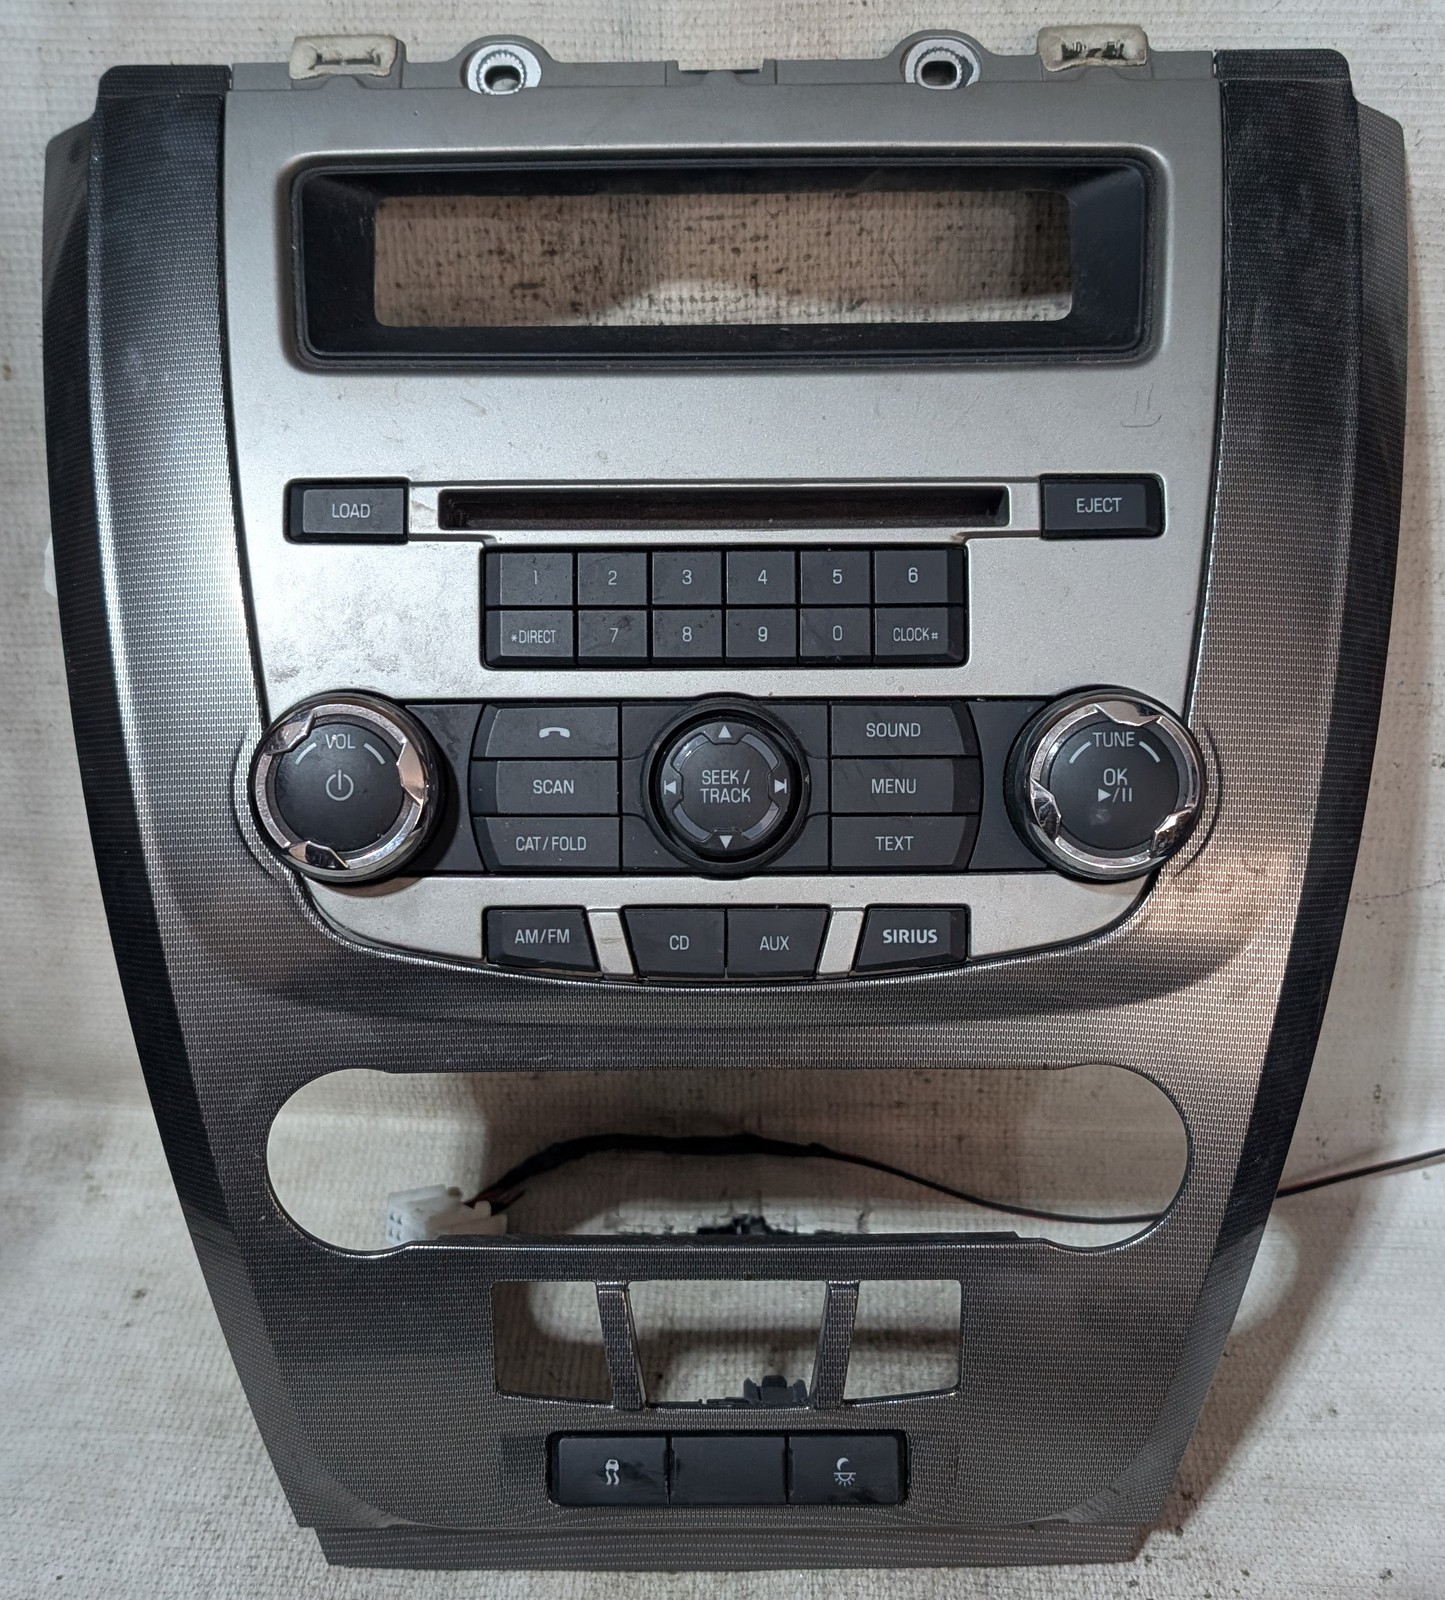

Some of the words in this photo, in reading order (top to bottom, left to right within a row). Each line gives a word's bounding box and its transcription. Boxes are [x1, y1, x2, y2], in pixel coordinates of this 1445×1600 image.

[331, 502, 371, 519] LOAD
[1076, 497, 1123, 513] EJECT
[608, 570, 618, 586] 2
[681, 569, 692, 585] 3
[757, 569, 768, 585] 4
[832, 568, 843, 585] 5
[908, 567, 919, 584] 6
[609, 627, 619, 643] 7
[682, 626, 693, 642] 8
[757, 626, 768, 643] 9
[832, 625, 843, 641] 0
[866, 722, 921, 738] SOUND
[324, 733, 356, 750] VOL
[1092, 731, 1135, 748] TUNE
[1103, 767, 1128, 786] OK
[532, 779, 574, 795] SCAN
[871, 778, 917, 794] MENU
[699, 787, 751, 804] TRACK
[874, 835, 914, 851] TEXT
[514, 928, 570, 944] AM/FM
[669, 934, 690, 951] CD
[759, 935, 790, 951] AUX
[882, 928, 938, 944] SIRIUS
